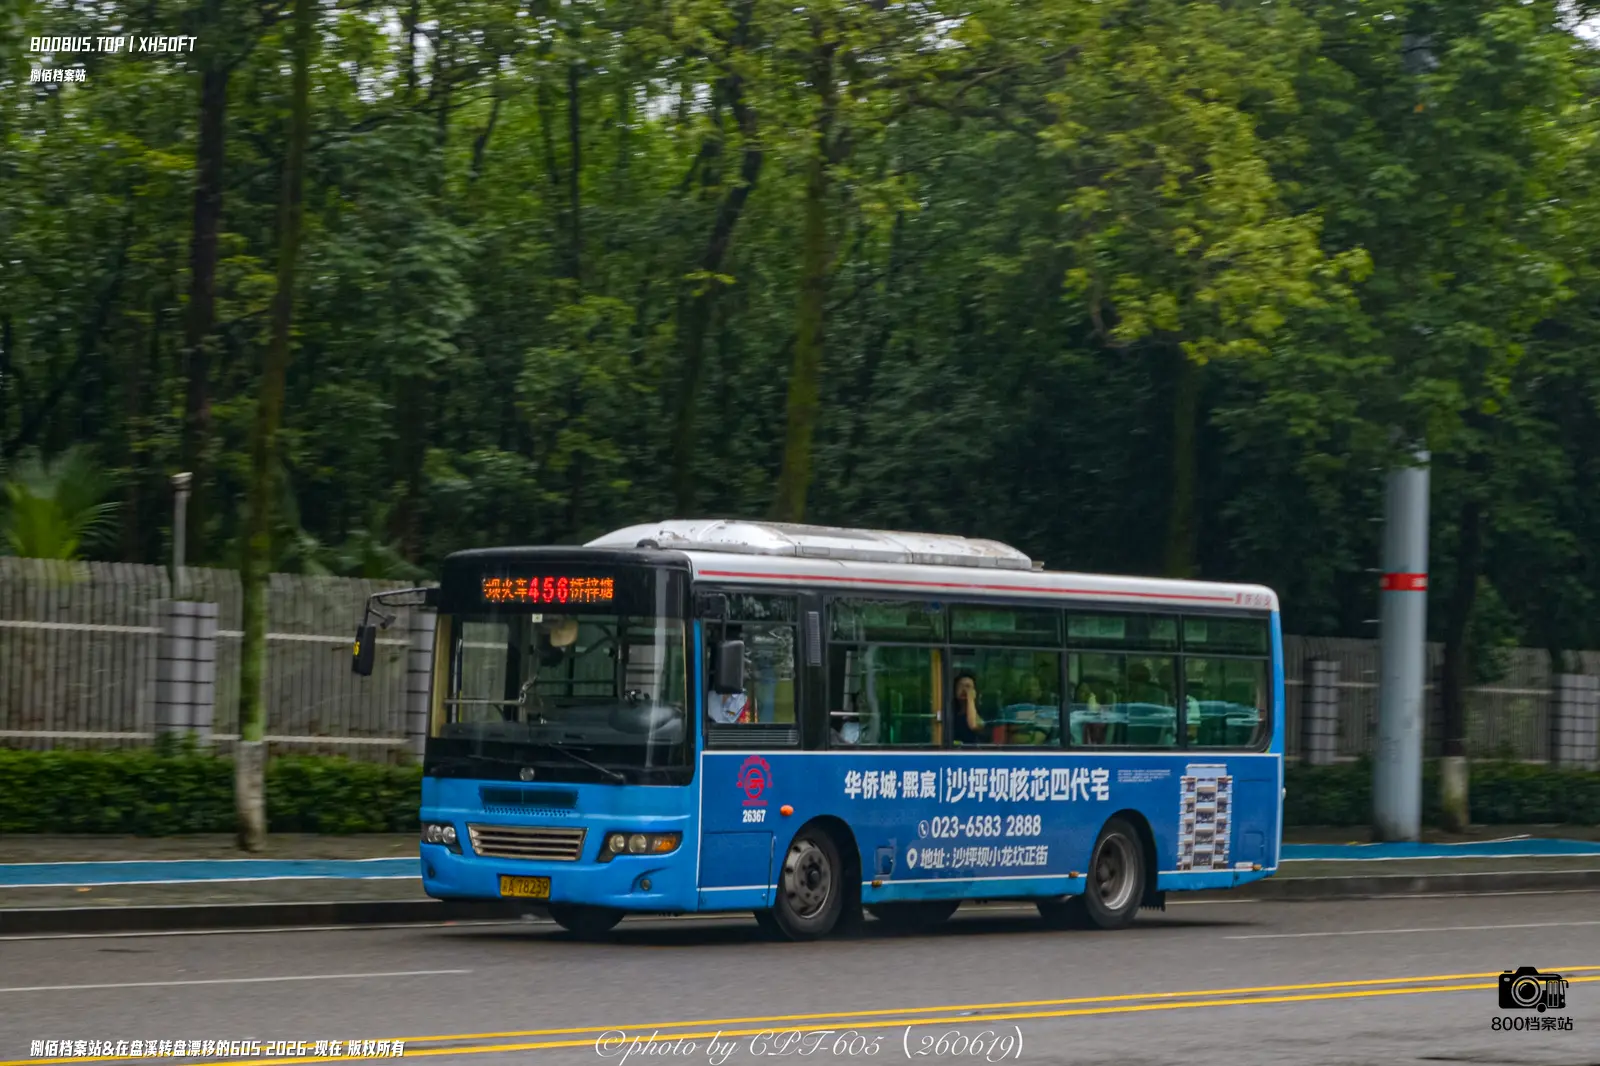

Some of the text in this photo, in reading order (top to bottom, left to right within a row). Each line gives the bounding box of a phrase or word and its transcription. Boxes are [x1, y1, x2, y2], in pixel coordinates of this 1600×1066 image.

[528, 576, 569, 604] 456
[946, 767, 1110, 803] 沙坪坝核芯四代宅
[931, 814, 1042, 838] 023-6583 2888
